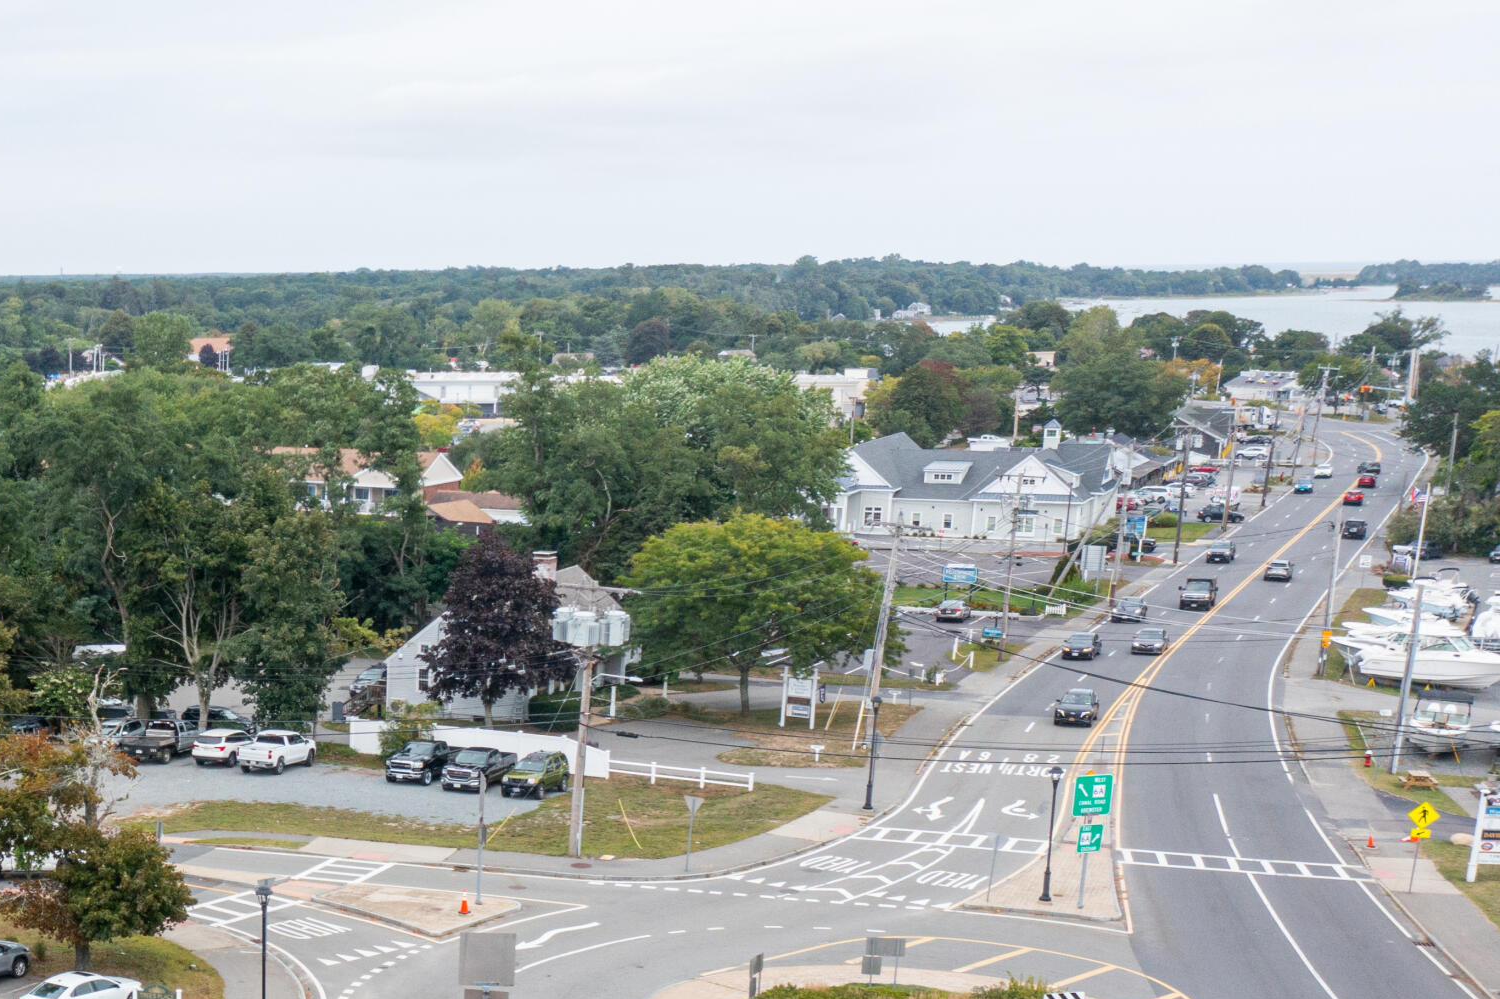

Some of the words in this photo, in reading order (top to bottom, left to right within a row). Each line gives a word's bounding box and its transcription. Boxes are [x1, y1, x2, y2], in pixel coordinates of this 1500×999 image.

[940, 762, 993, 774] WEST
[800, 856, 871, 873] YIELD
[916, 870, 990, 890] YIELD
